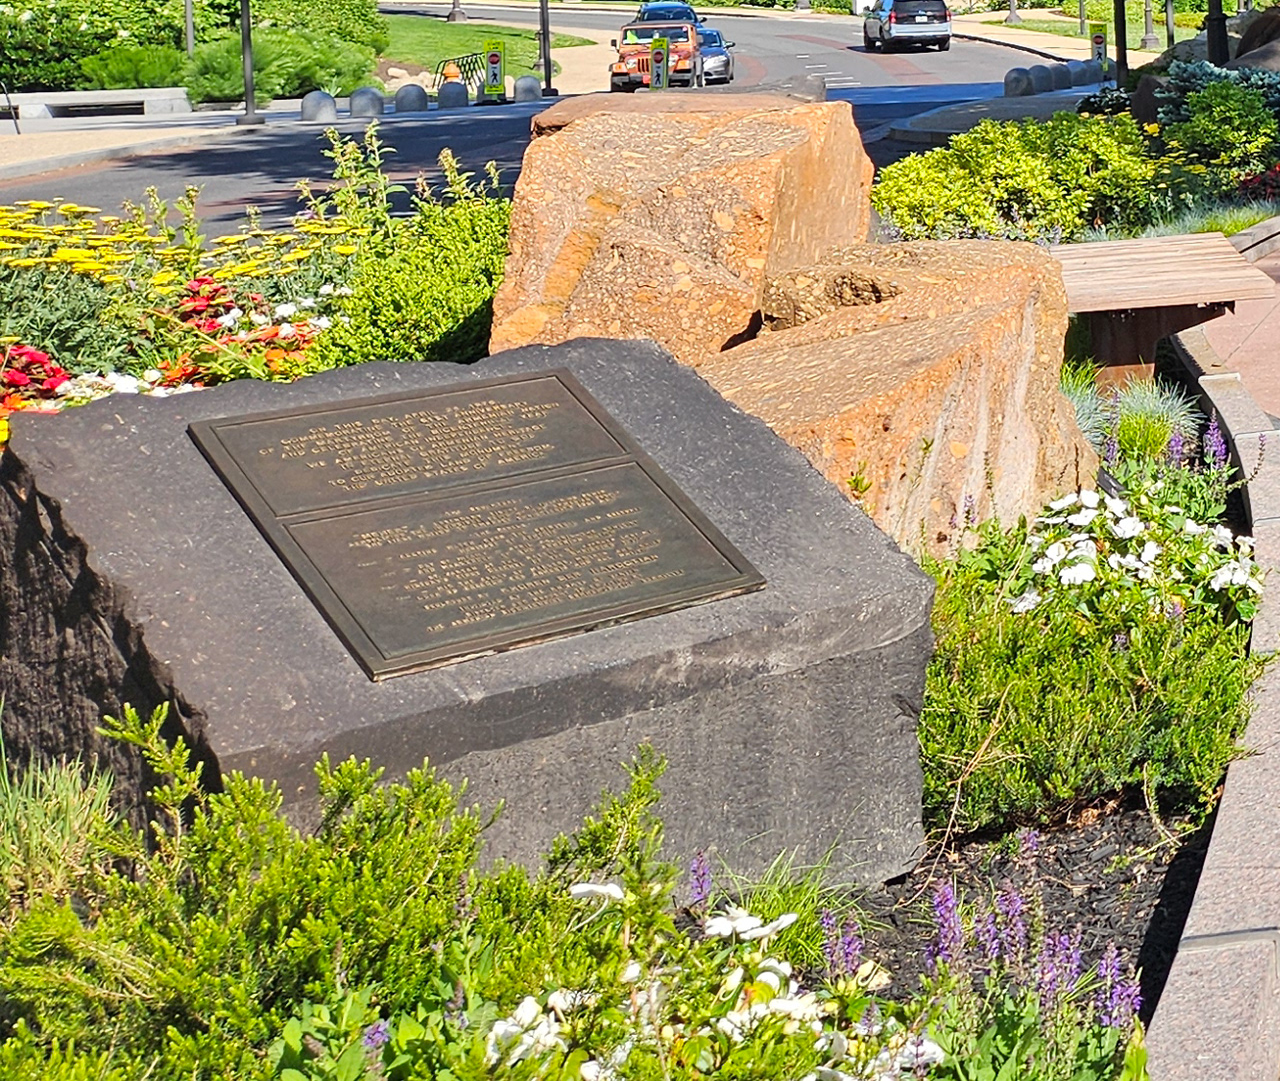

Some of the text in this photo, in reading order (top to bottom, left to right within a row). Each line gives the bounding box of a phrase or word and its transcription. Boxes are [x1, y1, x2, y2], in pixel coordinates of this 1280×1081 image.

[403, 410, 433, 418] APRIL
[280, 424, 382, 445] COMMEMORATING
[453, 402, 527, 417] ANNIVERSARY
[317, 430, 389, 445] MARTYRDOM
[457, 410, 514, 423] ARMENIAN
[520, 402, 559, 412] NATION
[311, 436, 392, 453] CELEBRATING
[334, 448, 403, 463] AMERICANS
[431, 435, 488, 448] ARMENIAN
[493, 424, 546, 437] HERITAGE
[361, 439, 418, 452] AMERICAN
[419, 443, 481, 457] GRATITUDE
[459, 442, 522, 457] MONUMENT
[350, 474, 376, 482] OUR
[440, 458, 470, 467] LAND
[423, 465, 468, 477] STATES
